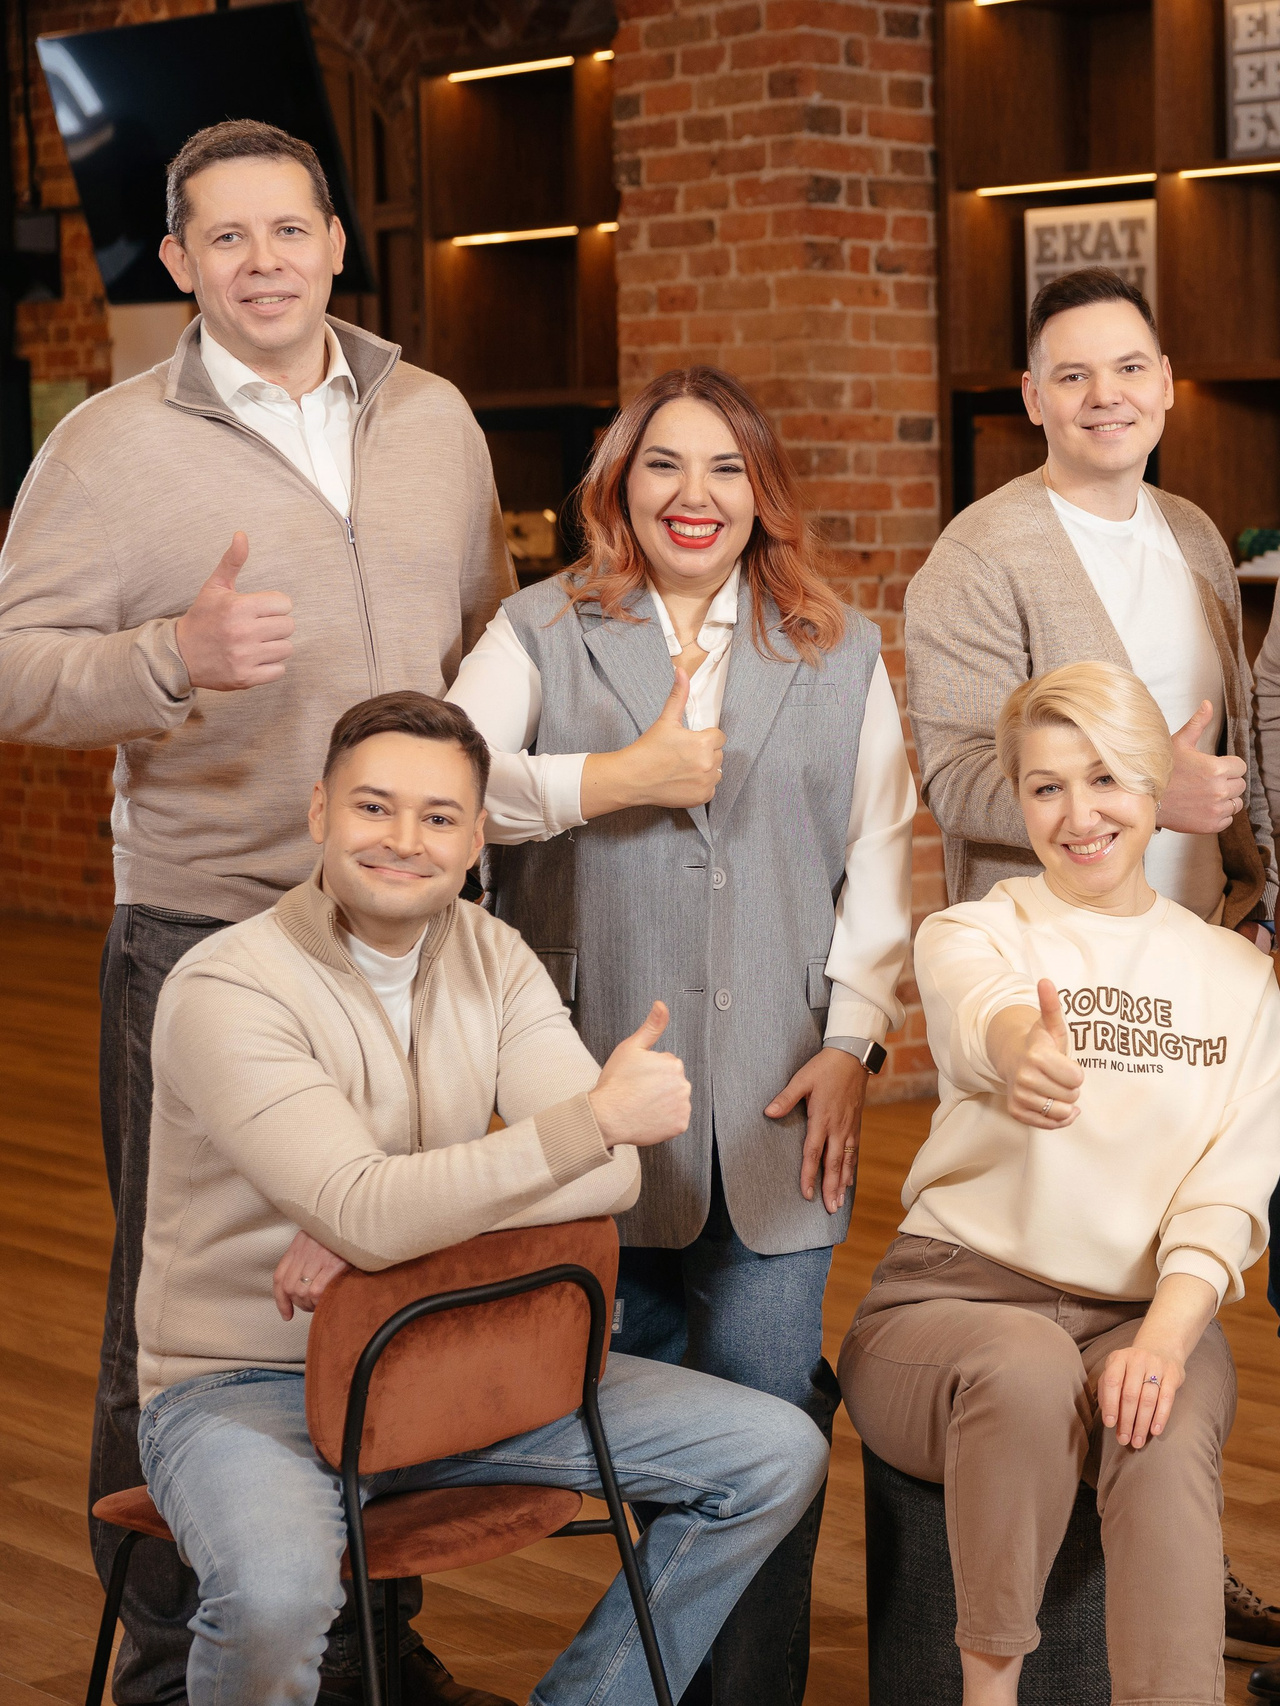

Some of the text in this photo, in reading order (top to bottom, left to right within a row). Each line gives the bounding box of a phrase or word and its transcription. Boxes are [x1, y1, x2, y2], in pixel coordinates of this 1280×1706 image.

[1034, 217, 1146, 265] ЕКАТ
[1067, 1020, 1227, 1067] TRENGTH
[1077, 1058, 1164, 1074] WITH NO LIMITS
